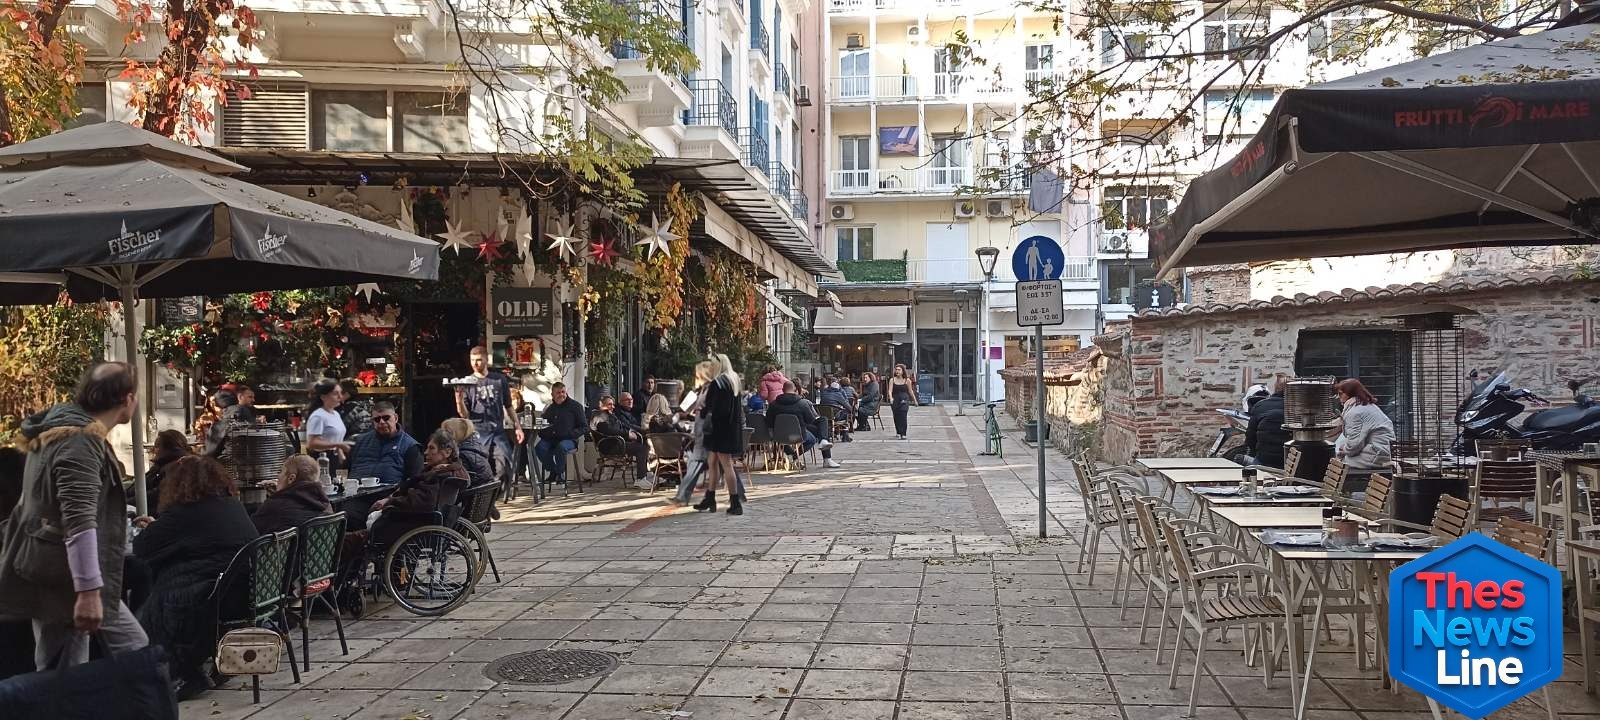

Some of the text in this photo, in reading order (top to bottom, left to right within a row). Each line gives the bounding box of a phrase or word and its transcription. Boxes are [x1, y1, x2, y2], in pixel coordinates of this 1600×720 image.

[1394, 108, 1465, 128] FRUTTI
[1529, 101, 1590, 120] MARE
[108, 229, 162, 255] Fischer
[257, 234, 288, 254] Fischer
[497, 301, 540, 317] OLD
